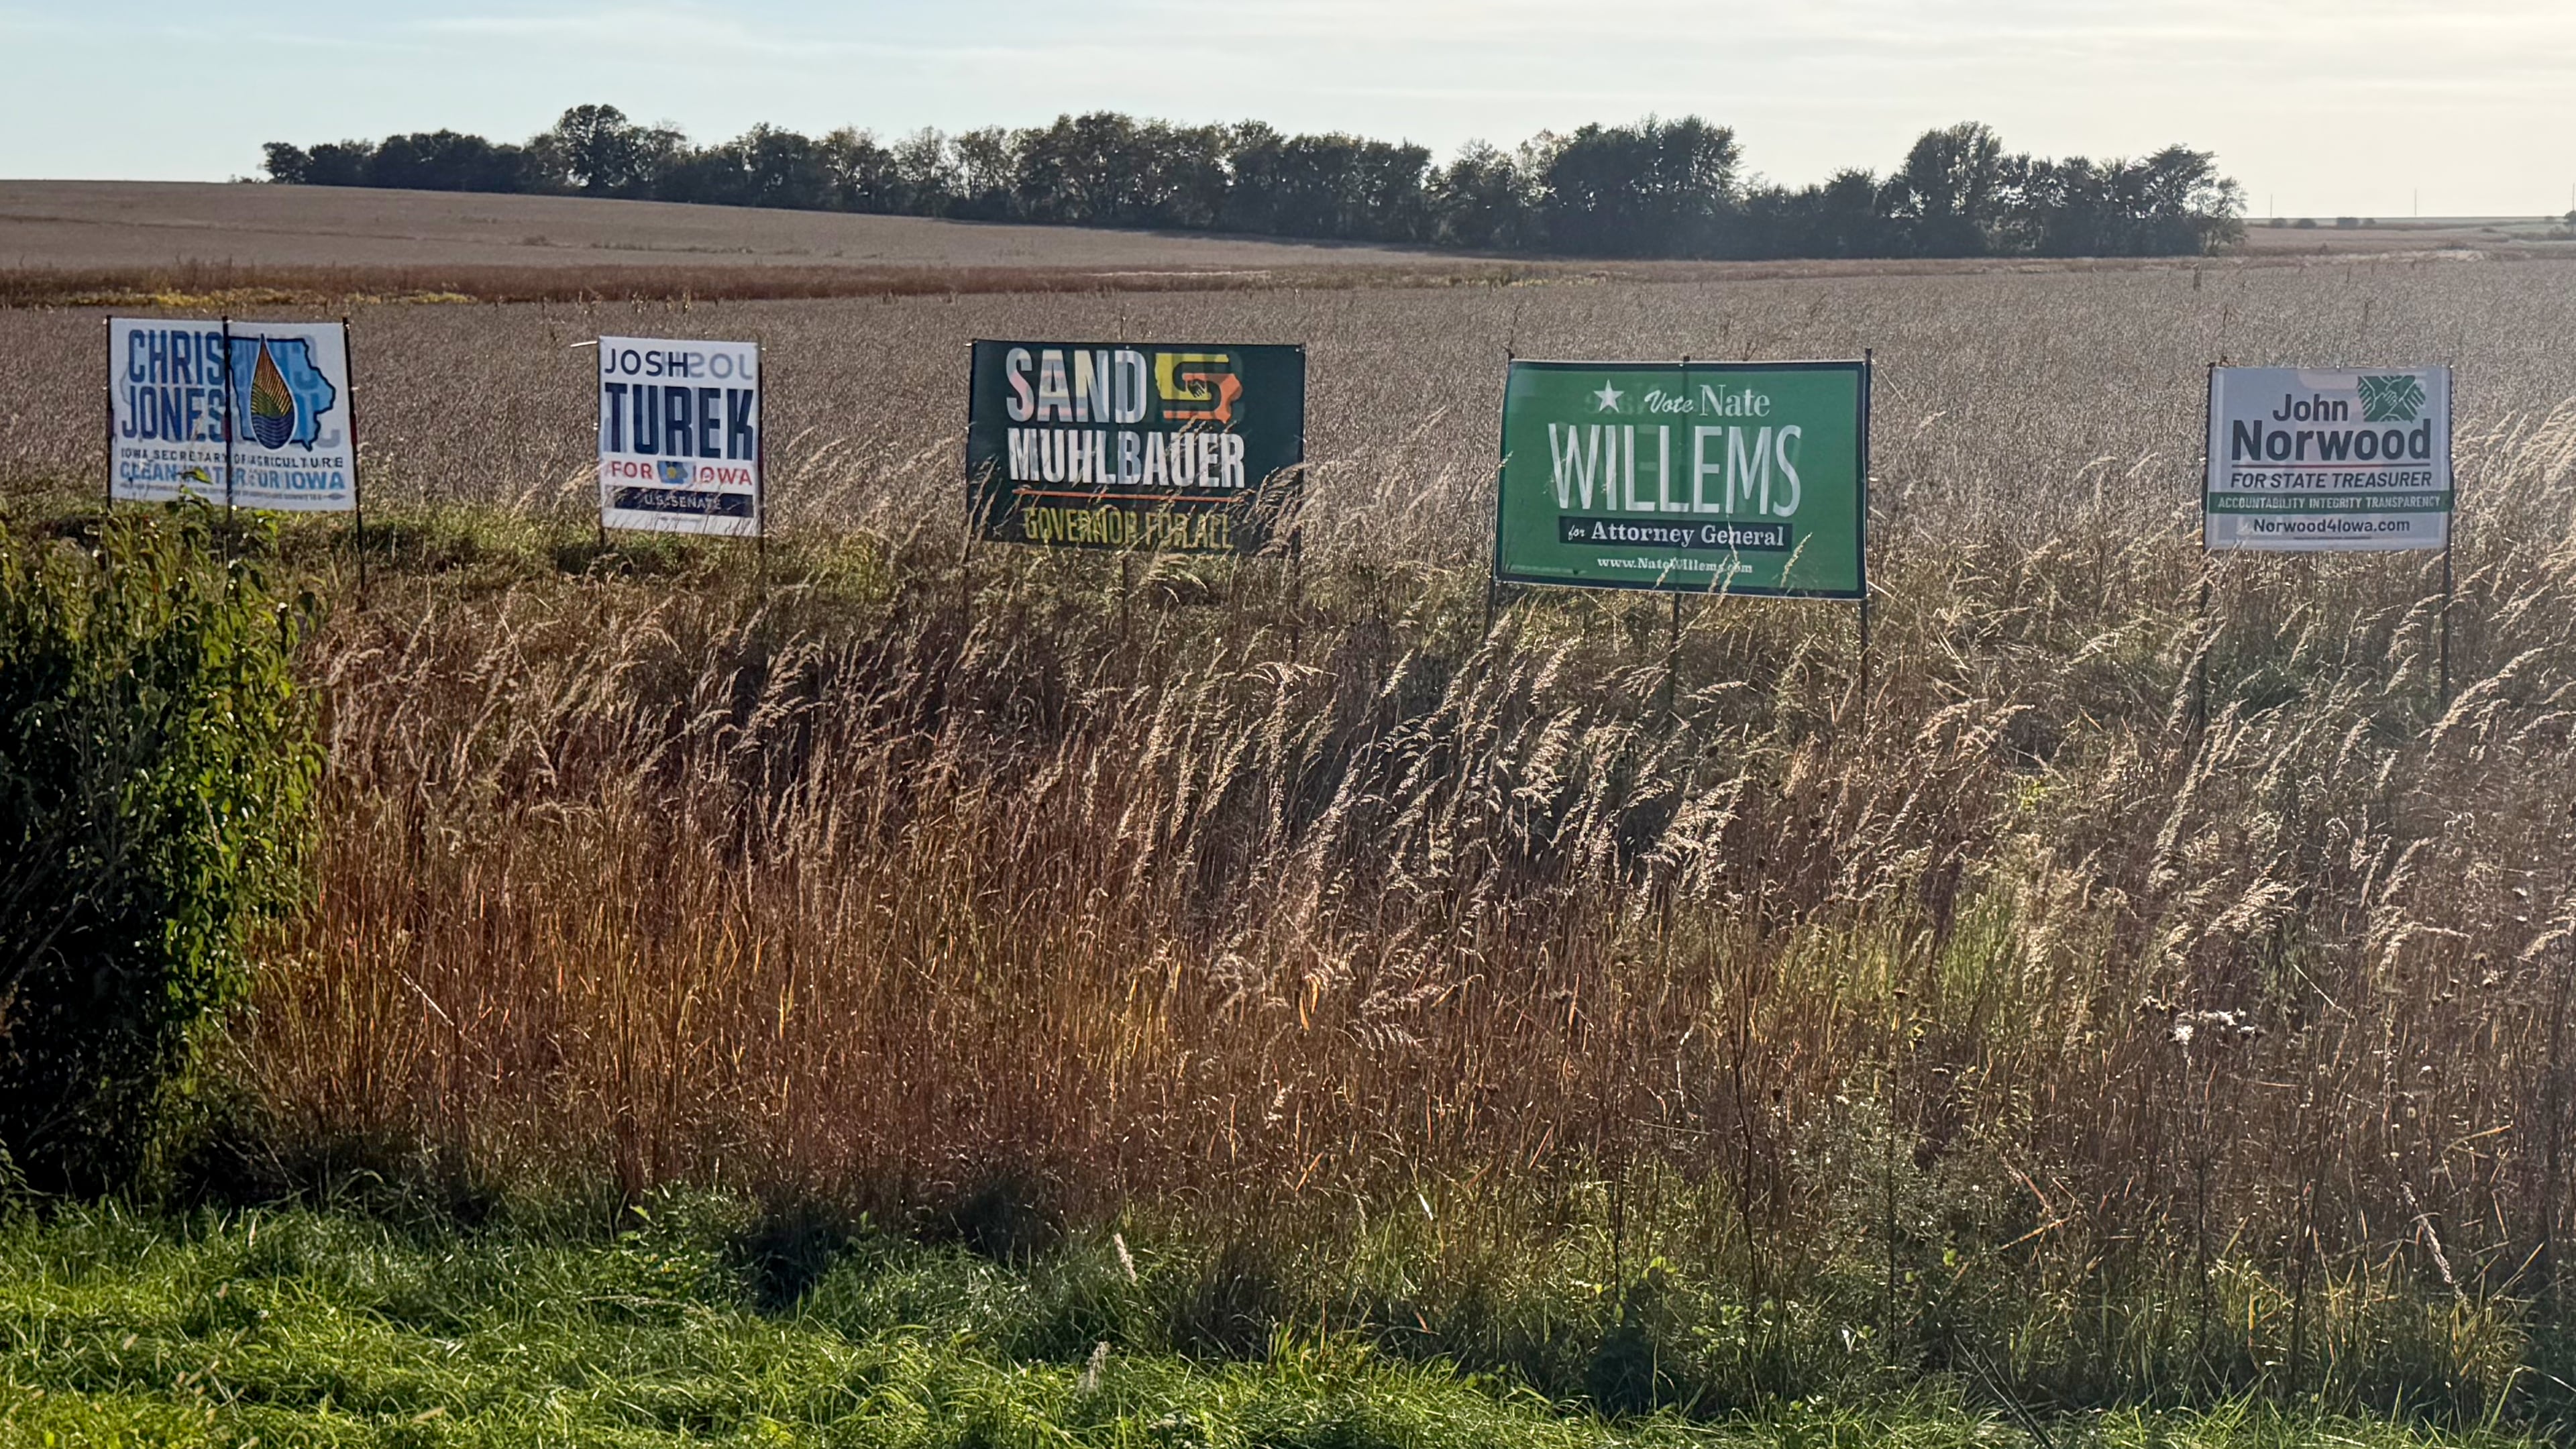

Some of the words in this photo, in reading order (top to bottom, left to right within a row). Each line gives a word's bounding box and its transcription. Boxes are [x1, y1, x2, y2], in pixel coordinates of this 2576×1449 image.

[128, 329, 225, 386] CHRIS
[604, 348, 688, 378] JOSH
[1006, 347, 1147, 424] SAND
[121, 385, 226, 443] JONES
[1644, 390, 1694, 414] Vote
[1699, 384, 1770, 418] Nate
[2273, 394, 2349, 422] John
[604, 382, 753, 462] TUREK
[2232, 419, 2431, 461] Norwood
[121, 448, 148, 459] IOWA
[153, 450, 227, 463] SECRETARY
[234, 454, 246, 464] OF
[250, 455, 343, 468] AGRICULTURE
[1008, 428, 1245, 488] MUHLBAUER
[1548, 423, 1802, 517] WILLEMS
[120, 461, 178, 482] CLEAN
[285, 471, 345, 490] IOWA
[611, 461, 653, 480] FOR
[693, 465, 753, 486] IOWA
[2231, 472, 2267, 488] FOR
[2270, 472, 2328, 489] STATE
[2332, 472, 2432, 488] TREASURER
[671, 495, 722, 510] SENATE
[2218, 496, 2306, 509] ACCOUNTABILITY
[2309, 496, 2362, 509] INTEGRITY
[2366, 495, 2441, 508] TRANSPARENCY
[1024, 506, 1138, 544] GOVERNOR
[1145, 512, 1188, 548] FOR
[1195, 513, 1234, 549] ALL
[1568, 525, 1586, 541] for
[1591, 521, 1695, 548] Attorney
[1701, 525, 1785, 546] General
[2253, 519, 2410, 533] Norwood4Iowa.com
[1597, 557, 1753, 573] www.NateWillems.com
